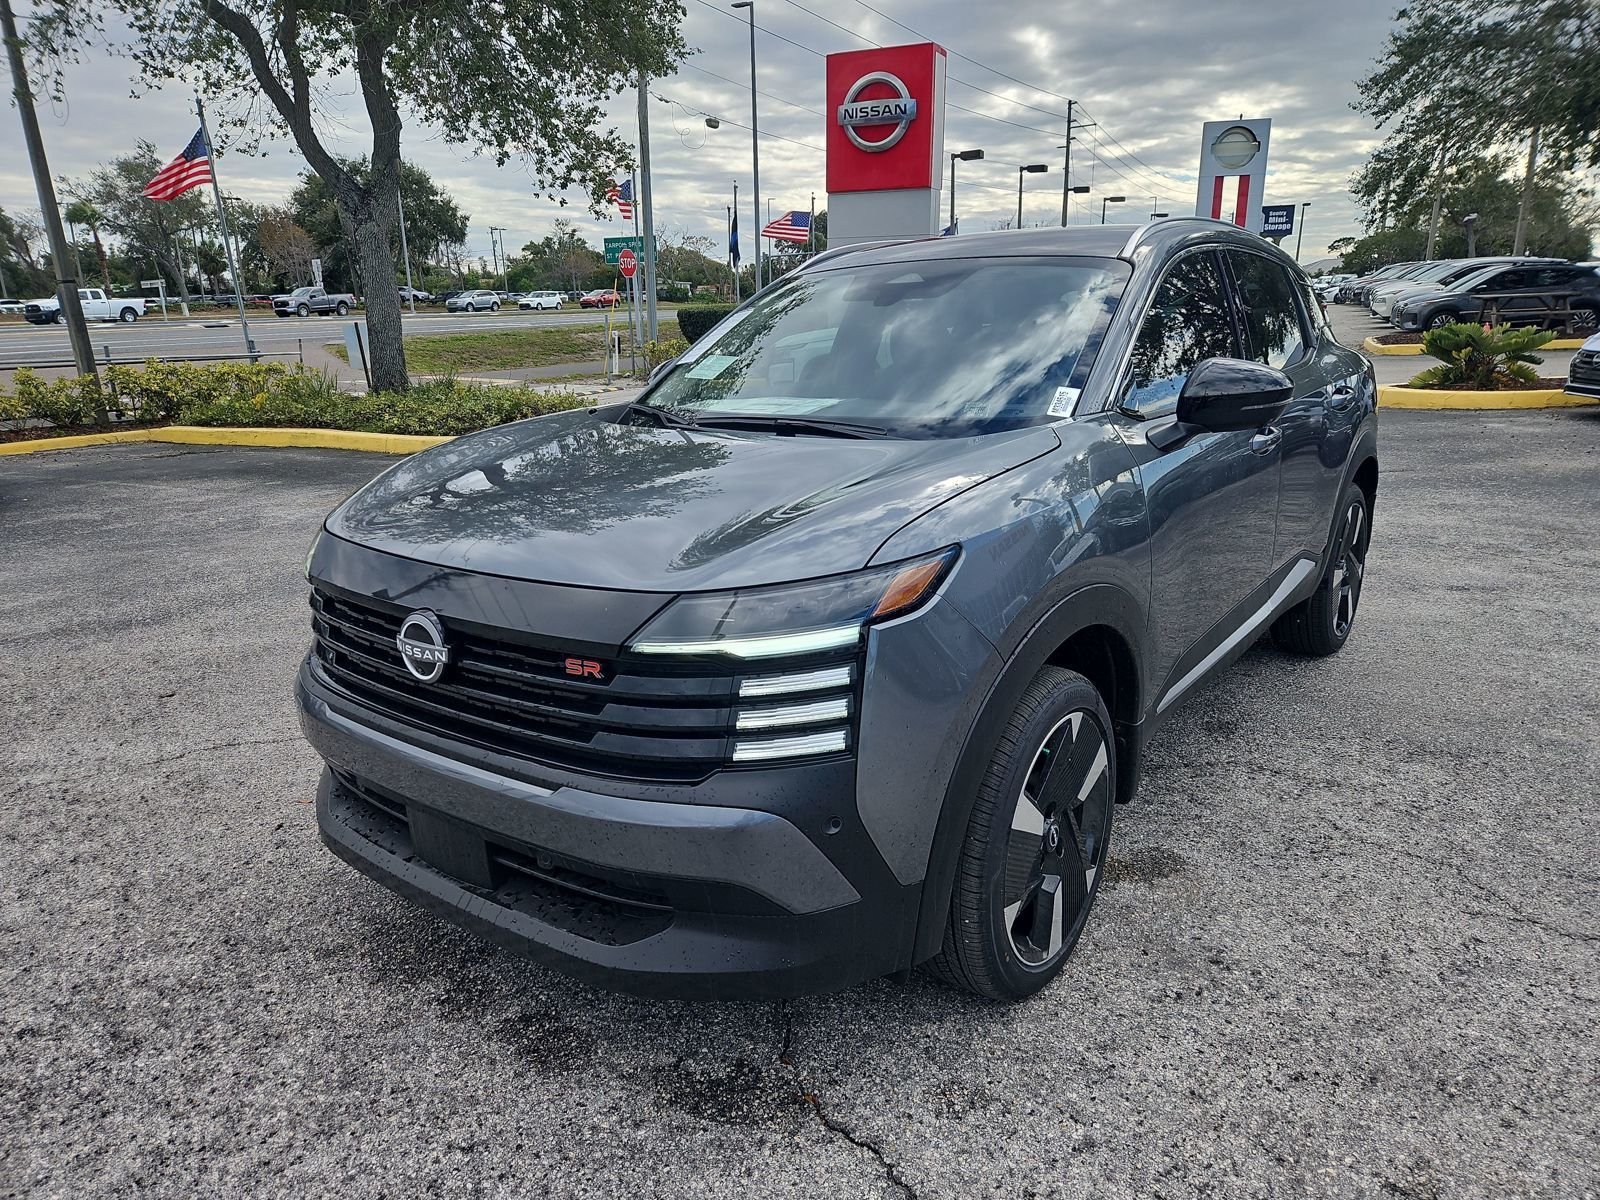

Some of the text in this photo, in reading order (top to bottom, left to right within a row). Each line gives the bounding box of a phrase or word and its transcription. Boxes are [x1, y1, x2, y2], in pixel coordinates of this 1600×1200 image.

[843, 103, 907, 121] NISSAN
[620, 258, 635, 268] STOP
[396, 638, 446, 661] NISSAN
[565, 658, 604, 679] SR
